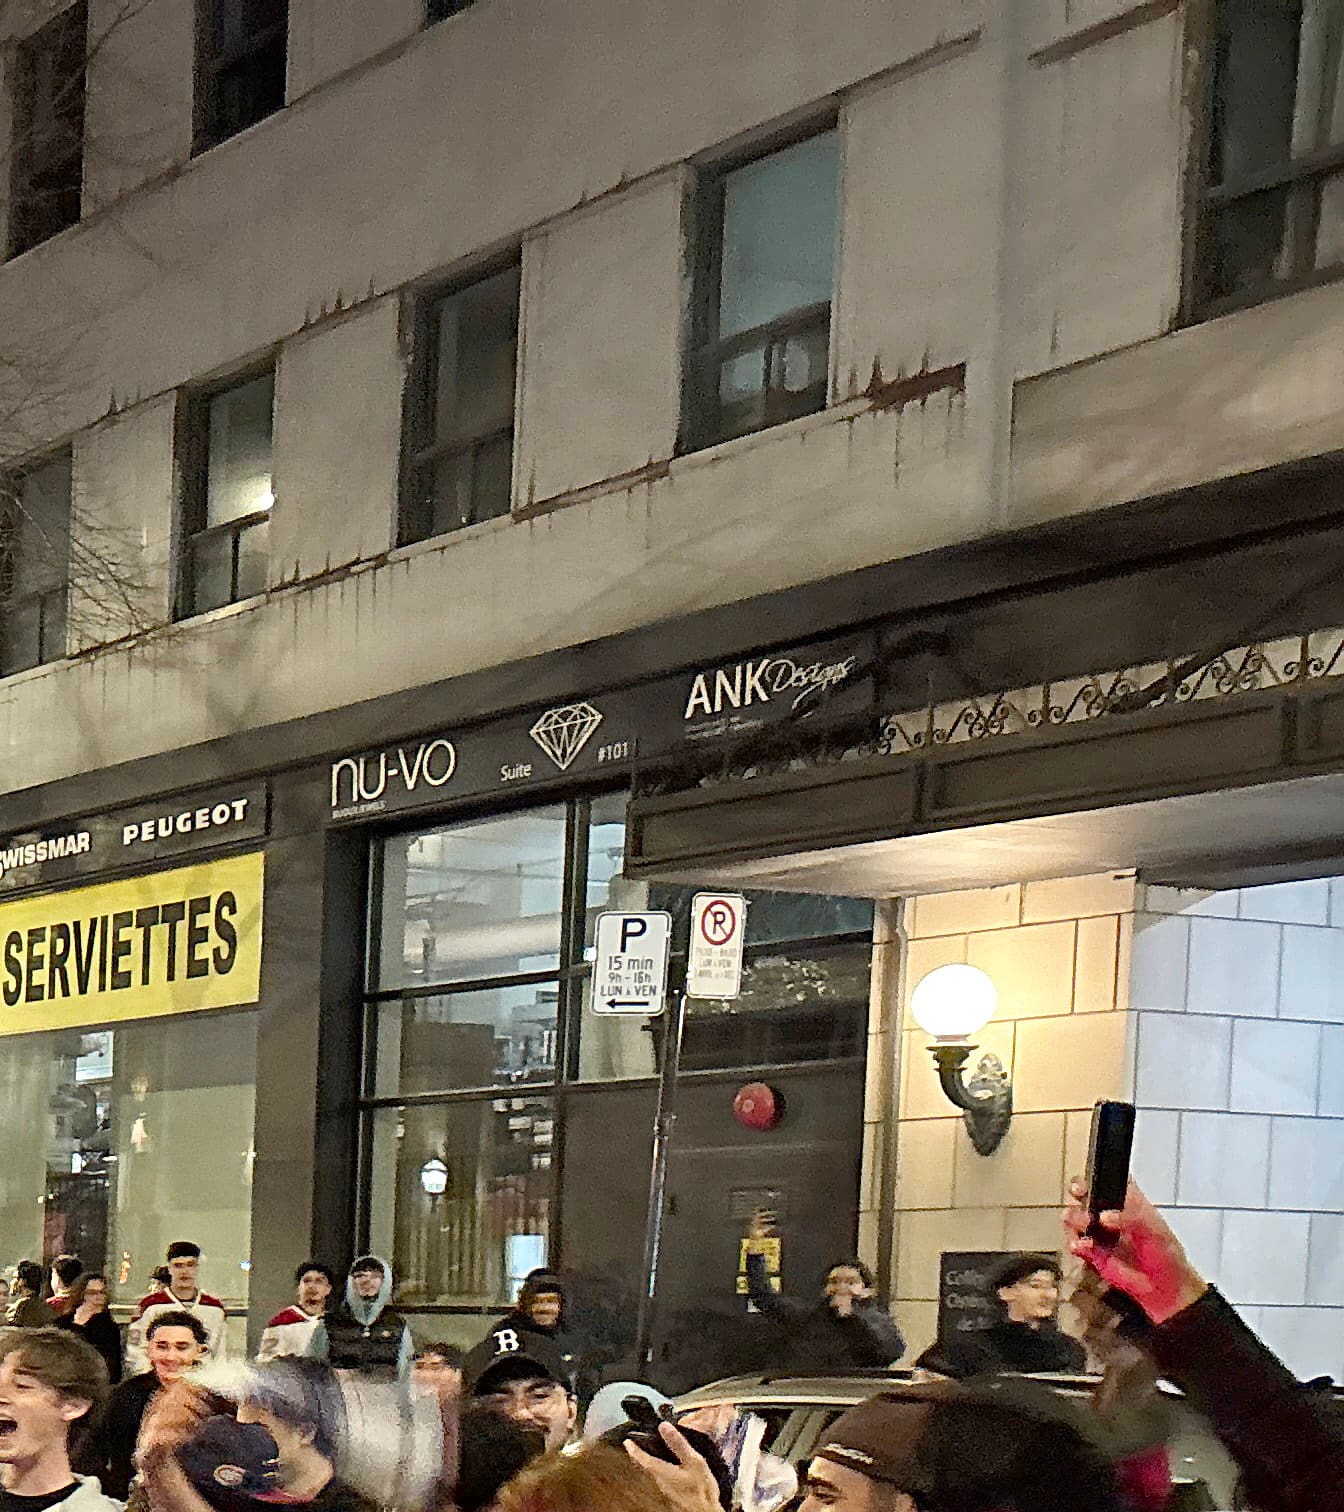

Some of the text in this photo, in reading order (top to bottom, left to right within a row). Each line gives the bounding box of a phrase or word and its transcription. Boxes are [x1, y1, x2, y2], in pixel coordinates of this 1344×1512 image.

[684, 658, 771, 720] ANK
[597, 741, 629, 764] #101
[500, 762, 533, 782] Suite
[123, 799, 248, 845] PEUGEOT
[1, 890, 238, 1007] SERVIETTES
[620, 918, 647, 953] P
[608, 955, 654, 971] 15 min
[600, 985, 623, 997] LUN
[634, 985, 657, 997] VEN
[493, 1329, 520, 1355] B
